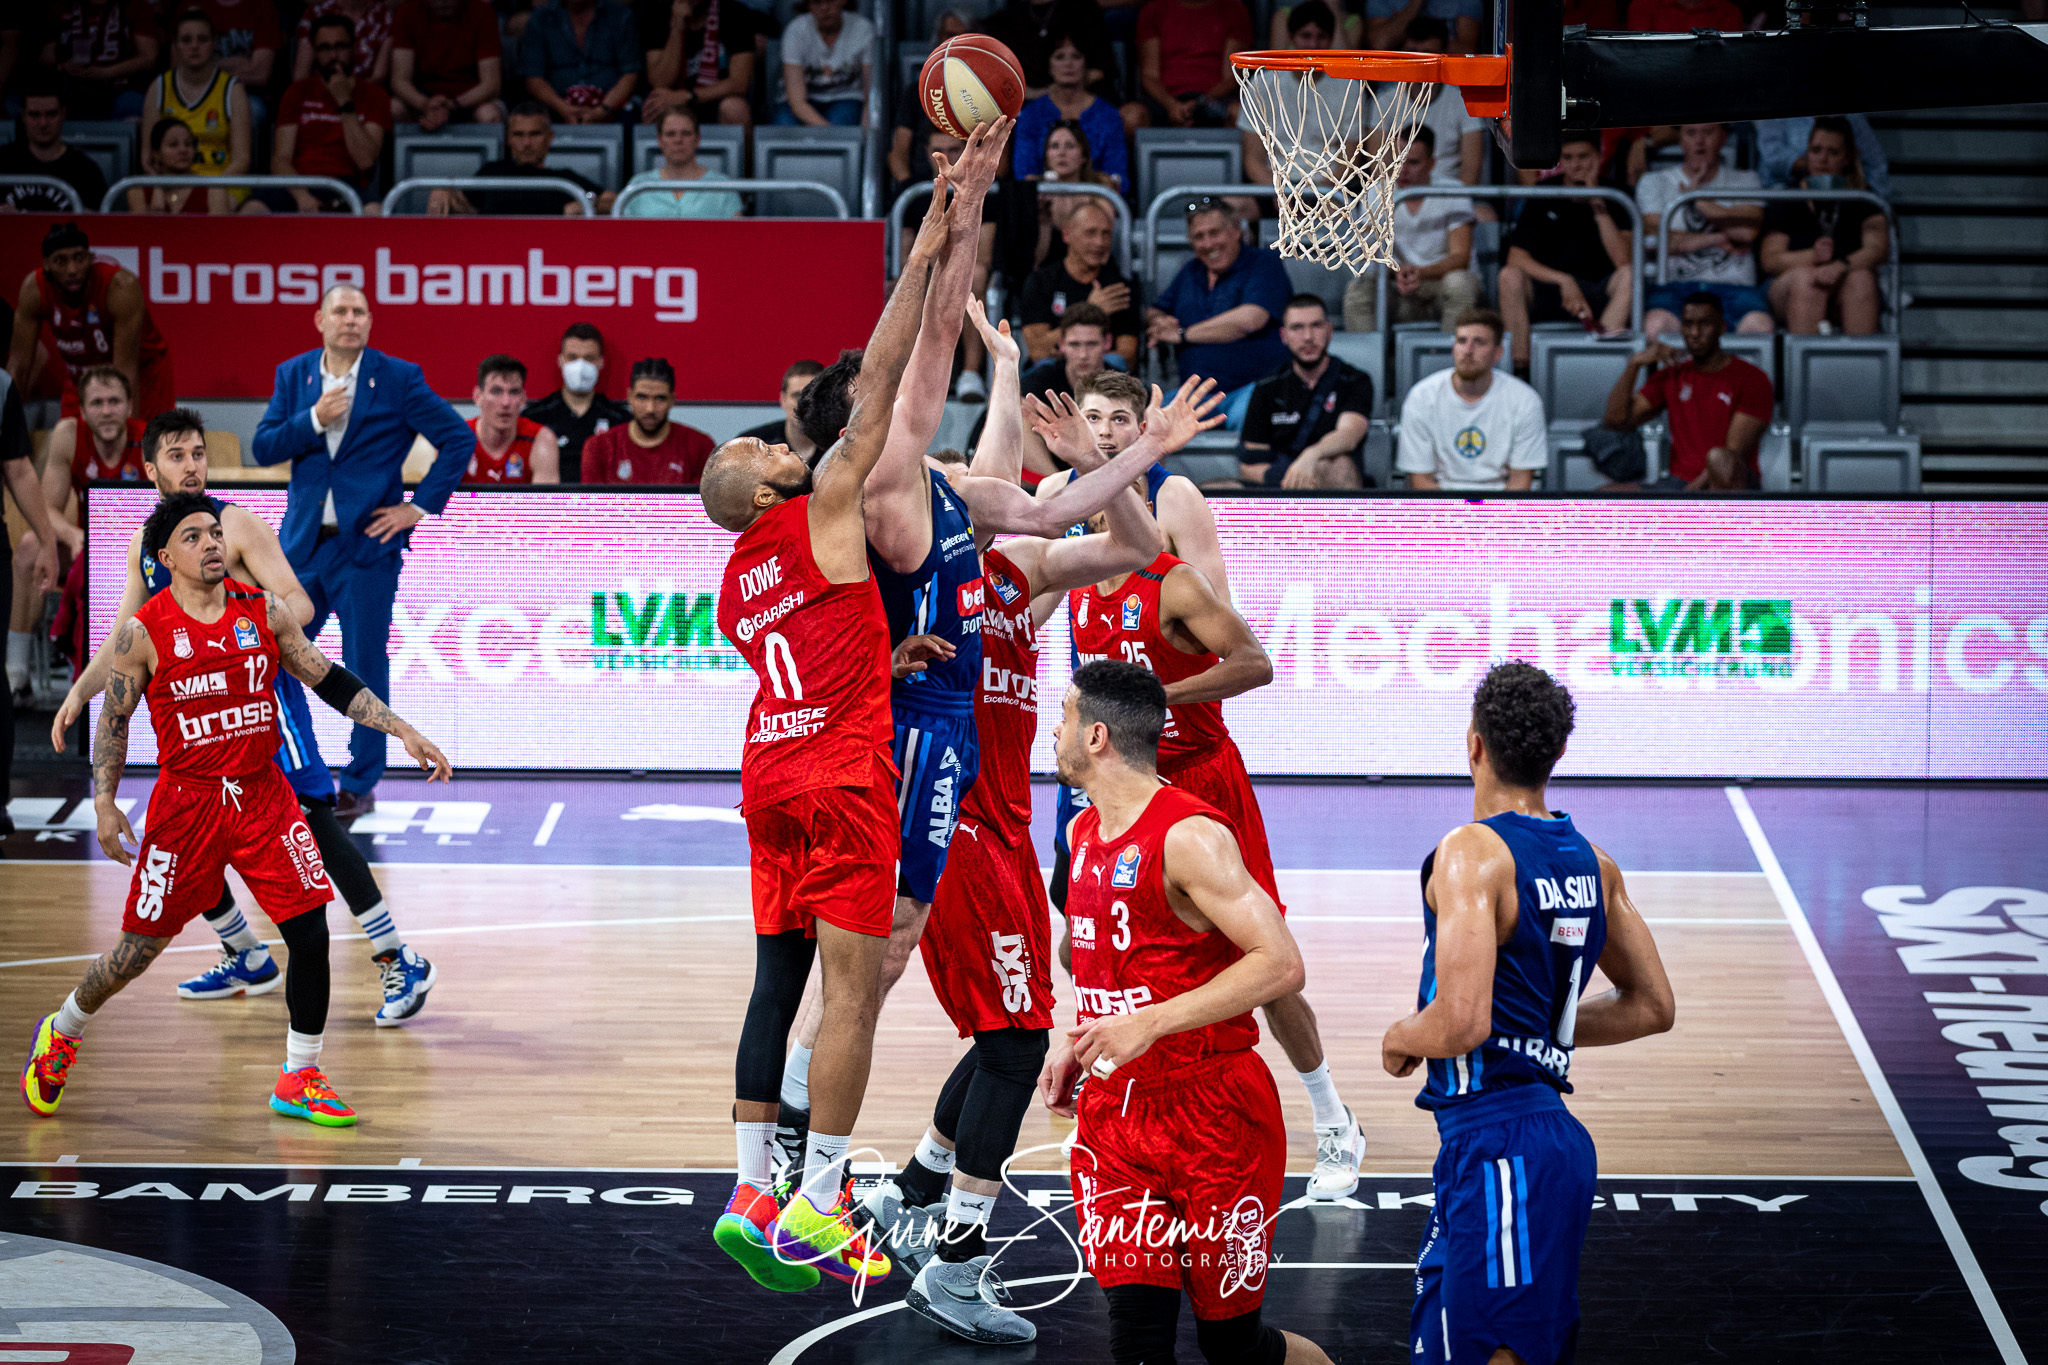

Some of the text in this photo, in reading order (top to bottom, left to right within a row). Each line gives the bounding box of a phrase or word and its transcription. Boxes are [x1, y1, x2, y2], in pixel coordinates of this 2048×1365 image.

[149, 246, 698, 323] brose bamberg
[93, 329, 109, 353] 8
[739, 556, 783, 602] DOWE
[592, 592, 716, 647] LVM
[1609, 599, 1735, 654] LVM
[244, 654, 268, 694] 12
[764, 631, 804, 700] 0
[1120, 640, 1153, 671] 25
[170, 673, 211, 696] LVM
[983, 656, 1038, 702] bros
[176, 701, 273, 741] brose
[759, 706, 829, 732] brose
[928, 776, 954, 848] ALBA
[136, 844, 173, 922] SIXT
[166, 874, 175, 895] rent
[281, 834, 311, 890] AUTOMATION
[1114, 873, 1133, 884] BBL
[1535, 877, 1566, 910] DA
[1110, 900, 1132, 951] 3
[990, 931, 1032, 1013] SIXT
[1556, 956, 1583, 1047] 1
[10, 1180, 696, 1206] BAMBERG
[1593, 1193, 1810, 1212] ITY
[1416, 1276, 1424, 1295] Wir
[1431, 1226, 1440, 1239] es
